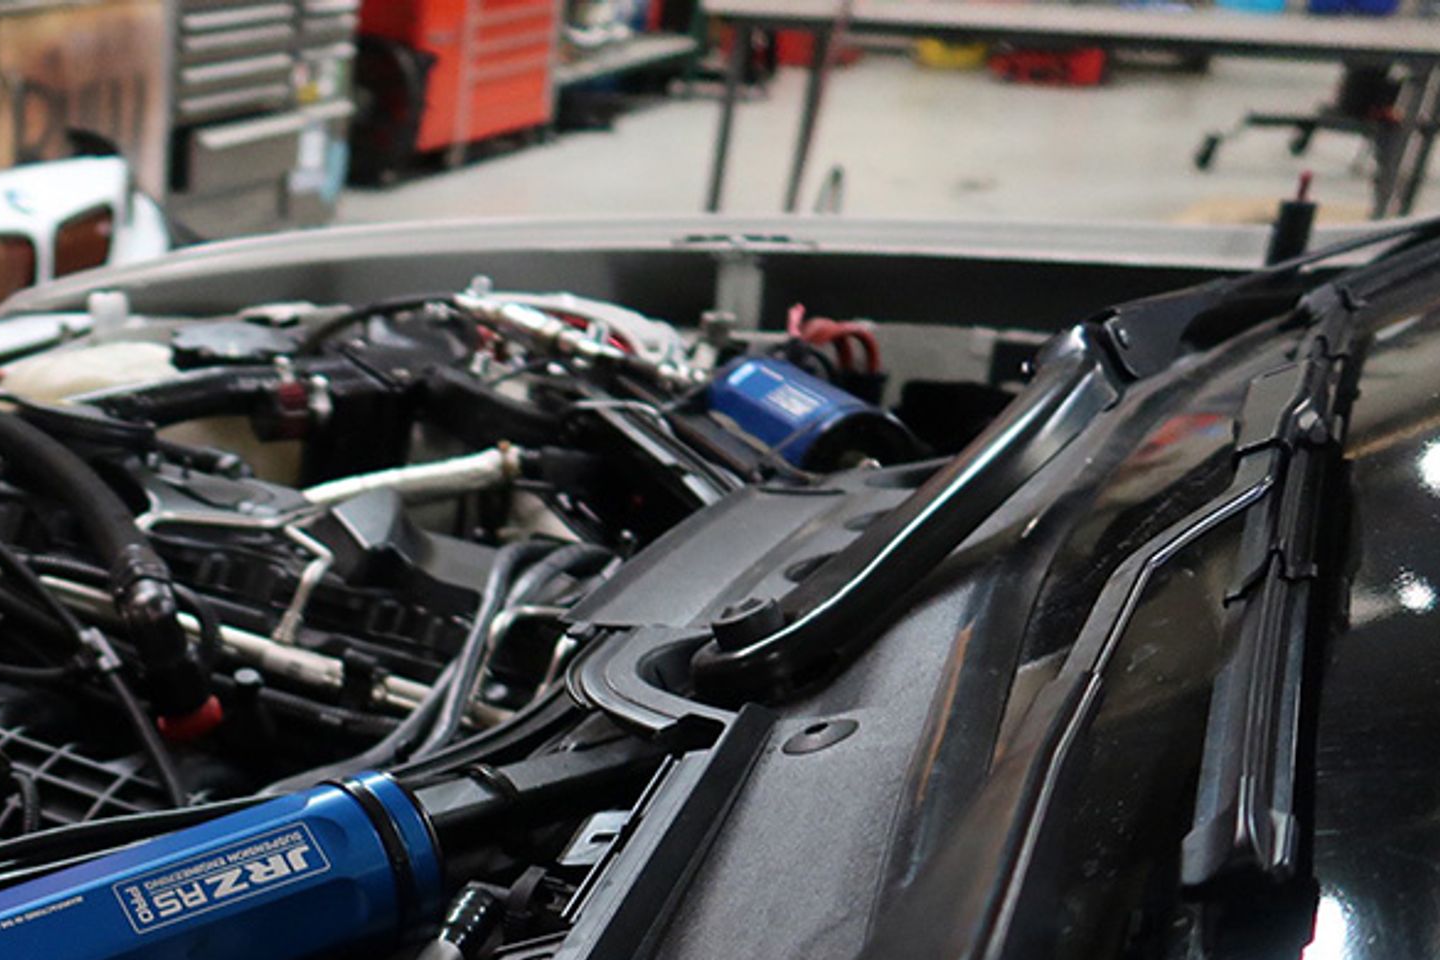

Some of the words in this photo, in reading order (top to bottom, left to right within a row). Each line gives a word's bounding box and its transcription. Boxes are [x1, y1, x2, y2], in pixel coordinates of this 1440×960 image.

[227, 831, 303, 863] SUSPENSION
[144, 857, 226, 890] ENGINEERING
[202, 844, 308, 898] JRZ
